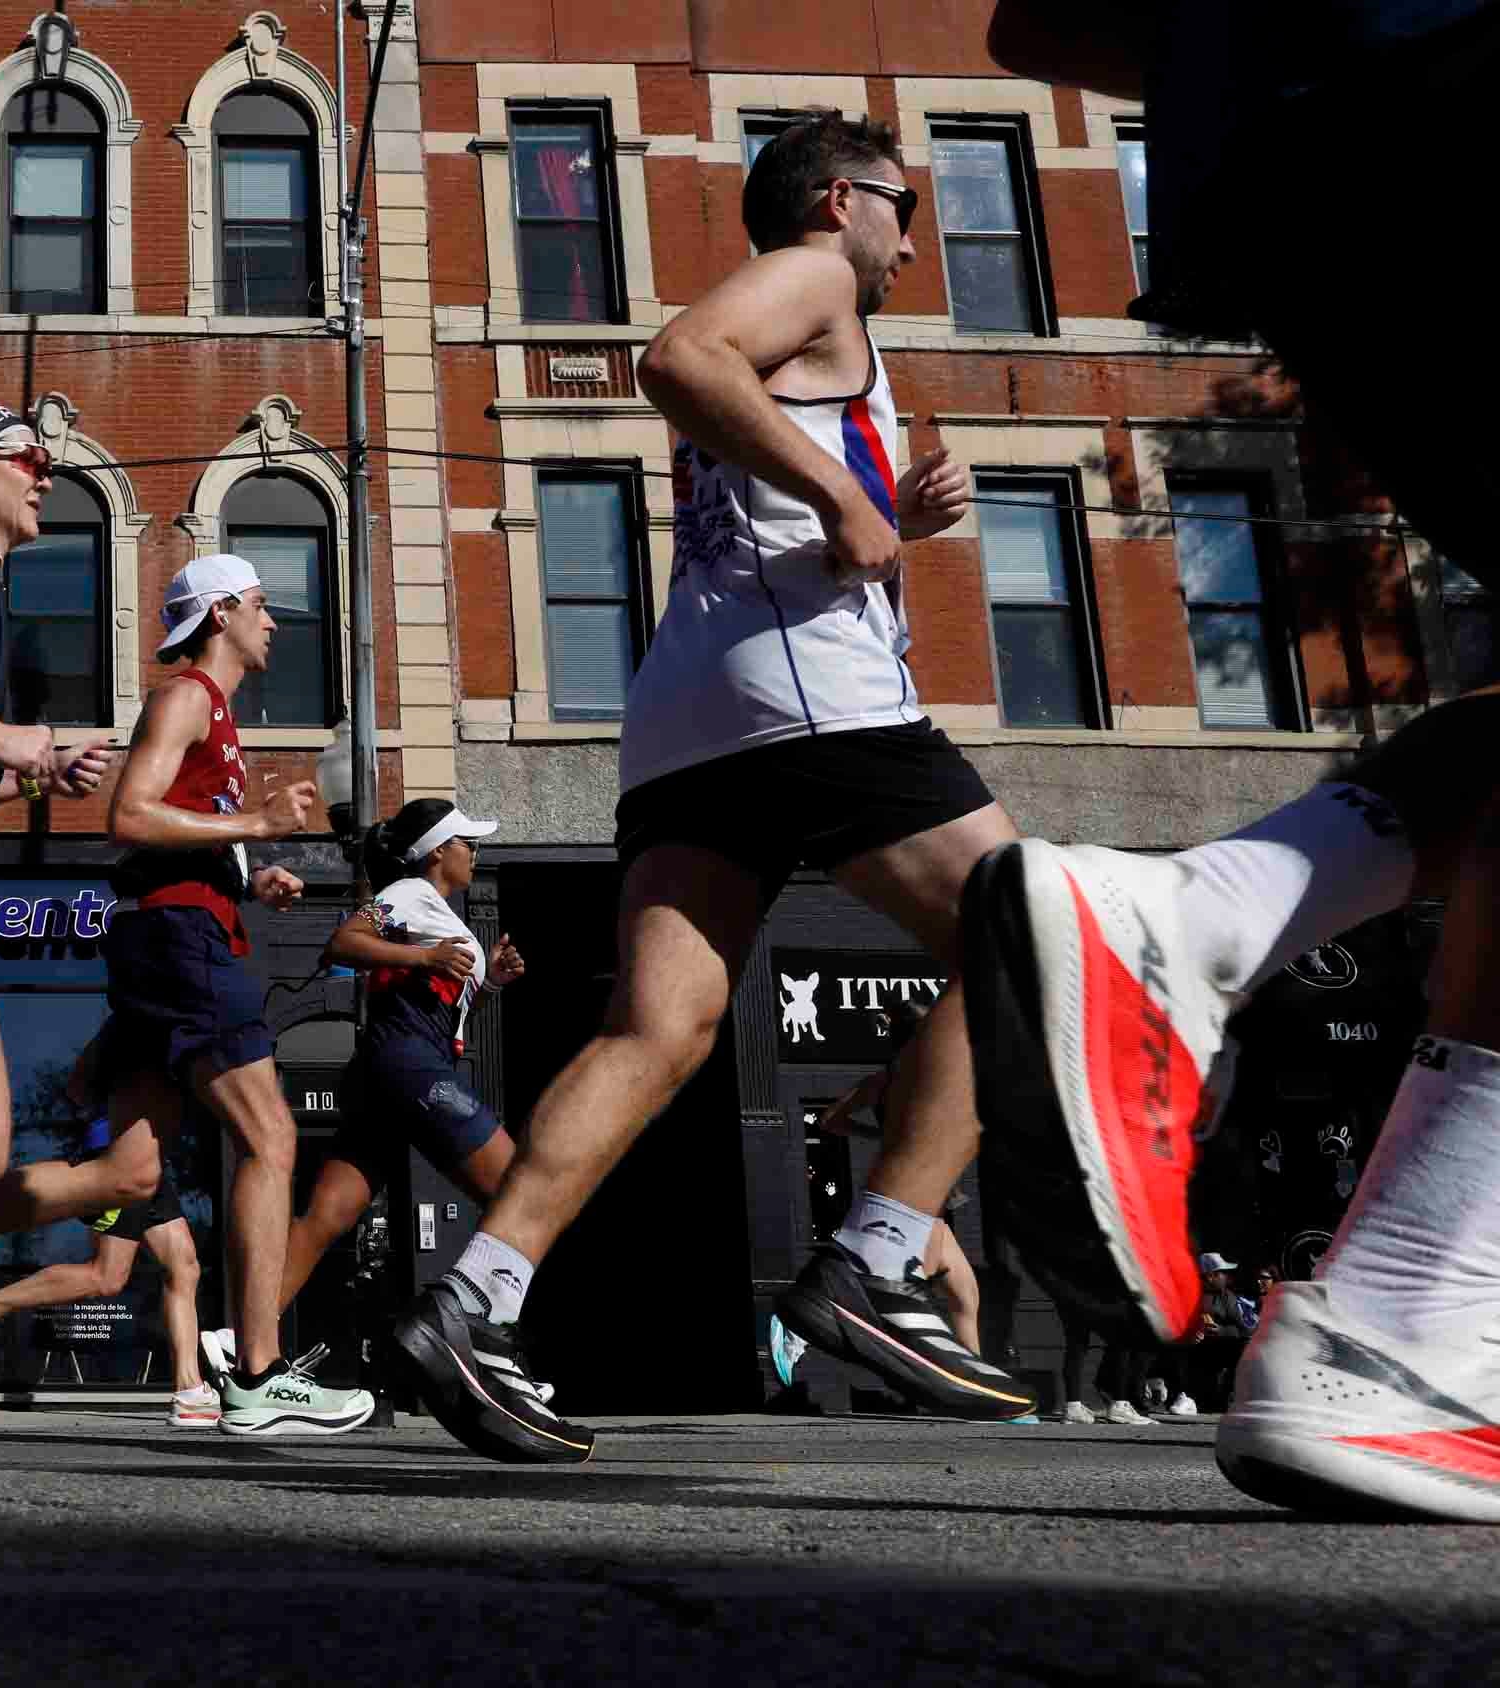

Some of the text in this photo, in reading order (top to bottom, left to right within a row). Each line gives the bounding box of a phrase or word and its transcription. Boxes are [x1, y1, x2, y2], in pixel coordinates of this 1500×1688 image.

[1326, 1022, 1379, 1041] 1040
[107, 1303, 116, 1311] de
[117, 1303, 127, 1311] los
[88, 1312, 111, 1322] tarjeta
[112, 1311, 133, 1320] médica
[87, 1324, 97, 1332] sin
[98, 1324, 111, 1332] cita
[265, 1386, 311, 1405] HOKA
